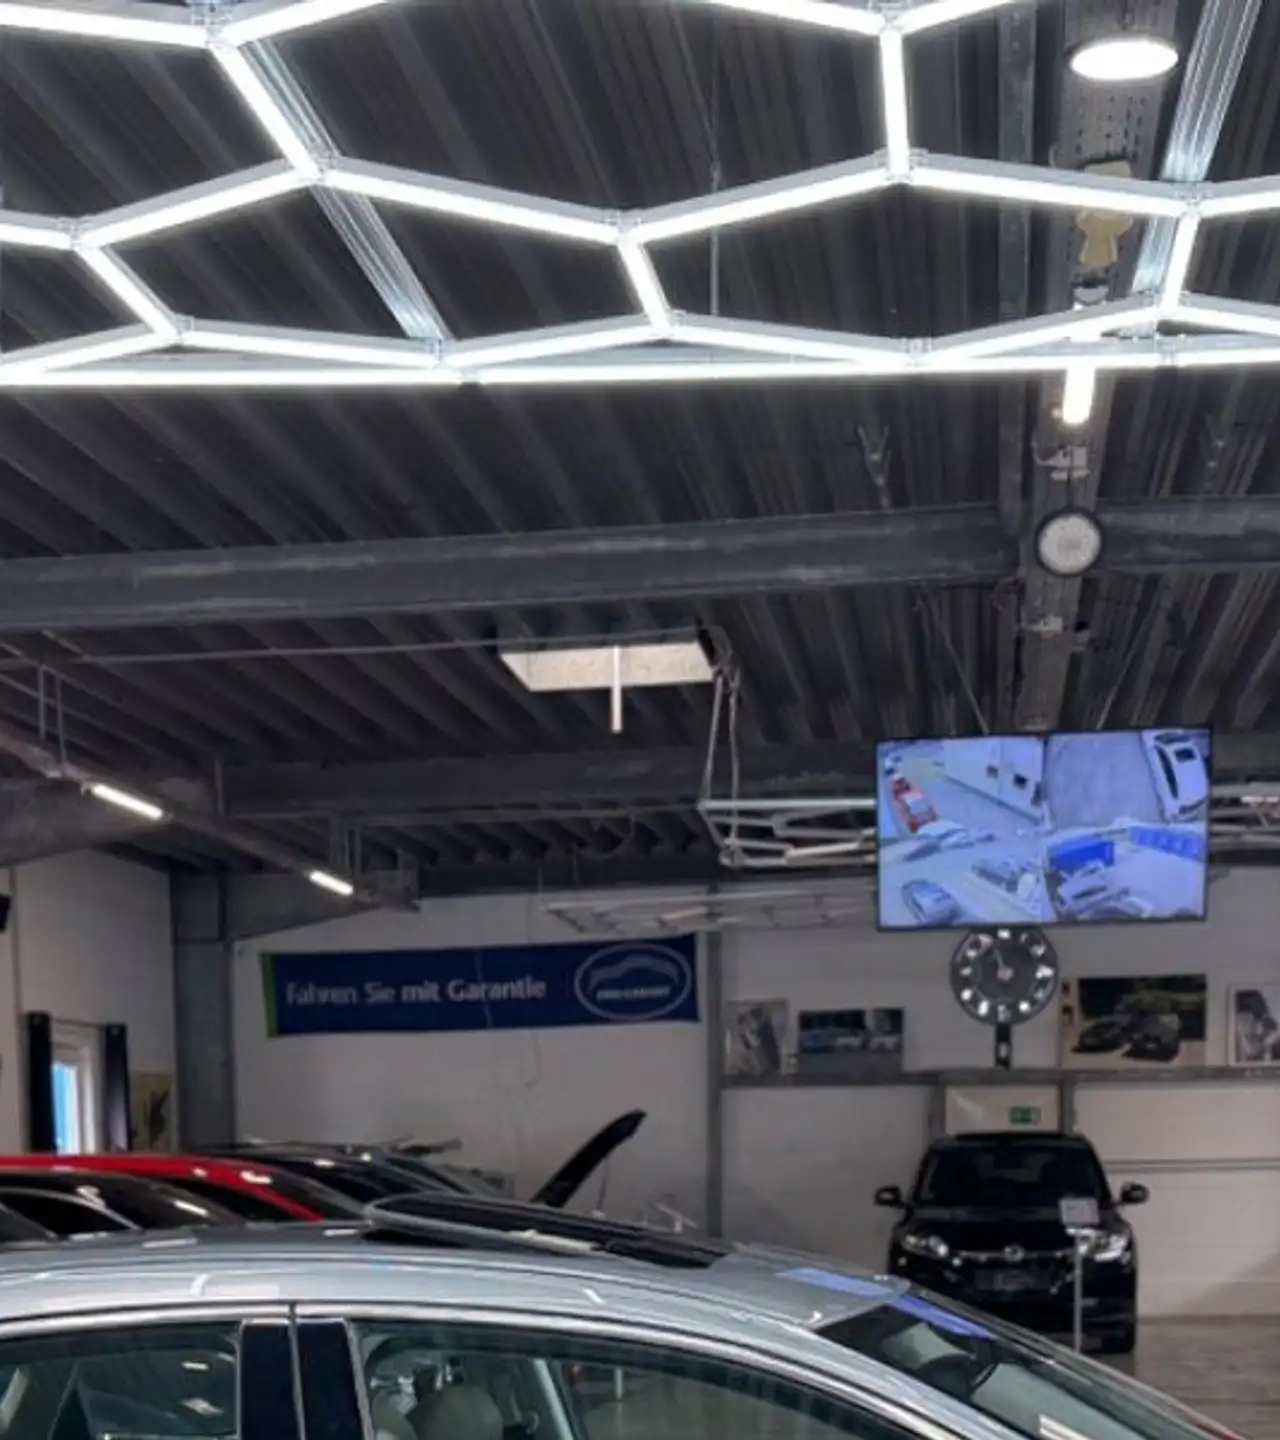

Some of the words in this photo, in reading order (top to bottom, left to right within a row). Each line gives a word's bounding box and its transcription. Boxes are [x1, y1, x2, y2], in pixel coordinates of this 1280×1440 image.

[285, 980, 358, 1006] Fahren
[364, 980, 397, 1004] Sie
[401, 978, 441, 1003] mit
[446, 975, 547, 1002] Garantie
